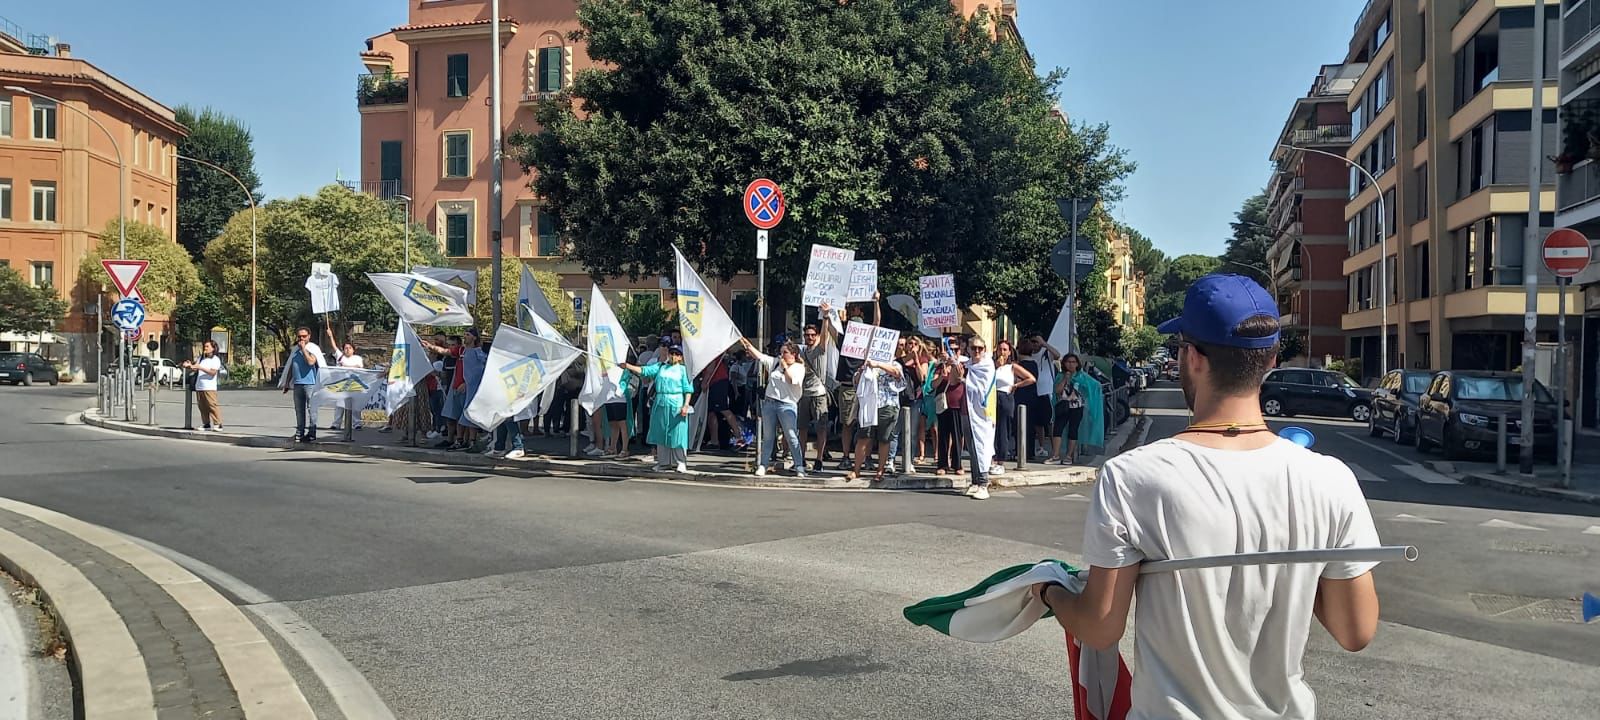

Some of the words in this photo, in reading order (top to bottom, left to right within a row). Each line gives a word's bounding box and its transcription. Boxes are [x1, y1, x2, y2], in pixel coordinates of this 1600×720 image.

[817, 261, 837, 272] OSS
[813, 281, 835, 290] COOP
[852, 336, 860, 344] E
